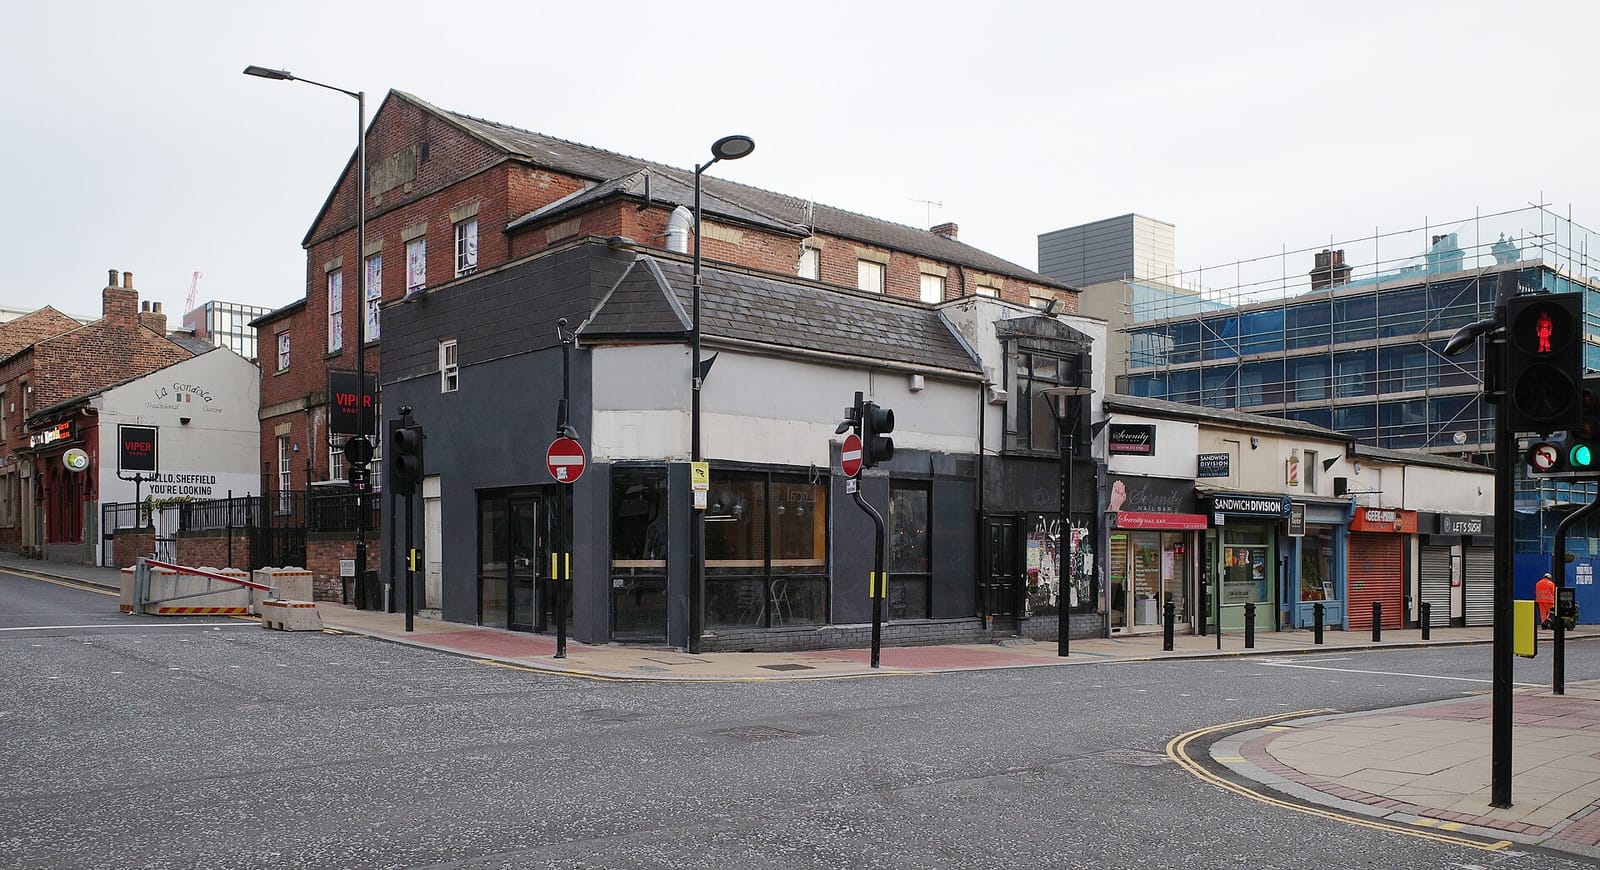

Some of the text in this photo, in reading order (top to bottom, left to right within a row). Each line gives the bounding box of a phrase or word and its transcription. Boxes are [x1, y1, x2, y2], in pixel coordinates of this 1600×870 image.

[1113, 429, 1149, 447] Serenity
[125, 441, 152, 452] VIPER
[176, 474, 216, 485] SHEFFIELD
[179, 485, 212, 496] LOOKING
[1128, 482, 1184, 513] Serenity
[1214, 498, 1281, 512] SANDWICH DIVISION
[1118, 513, 1144, 527] Serenity
[1467, 522, 1482, 533] SUSHI
